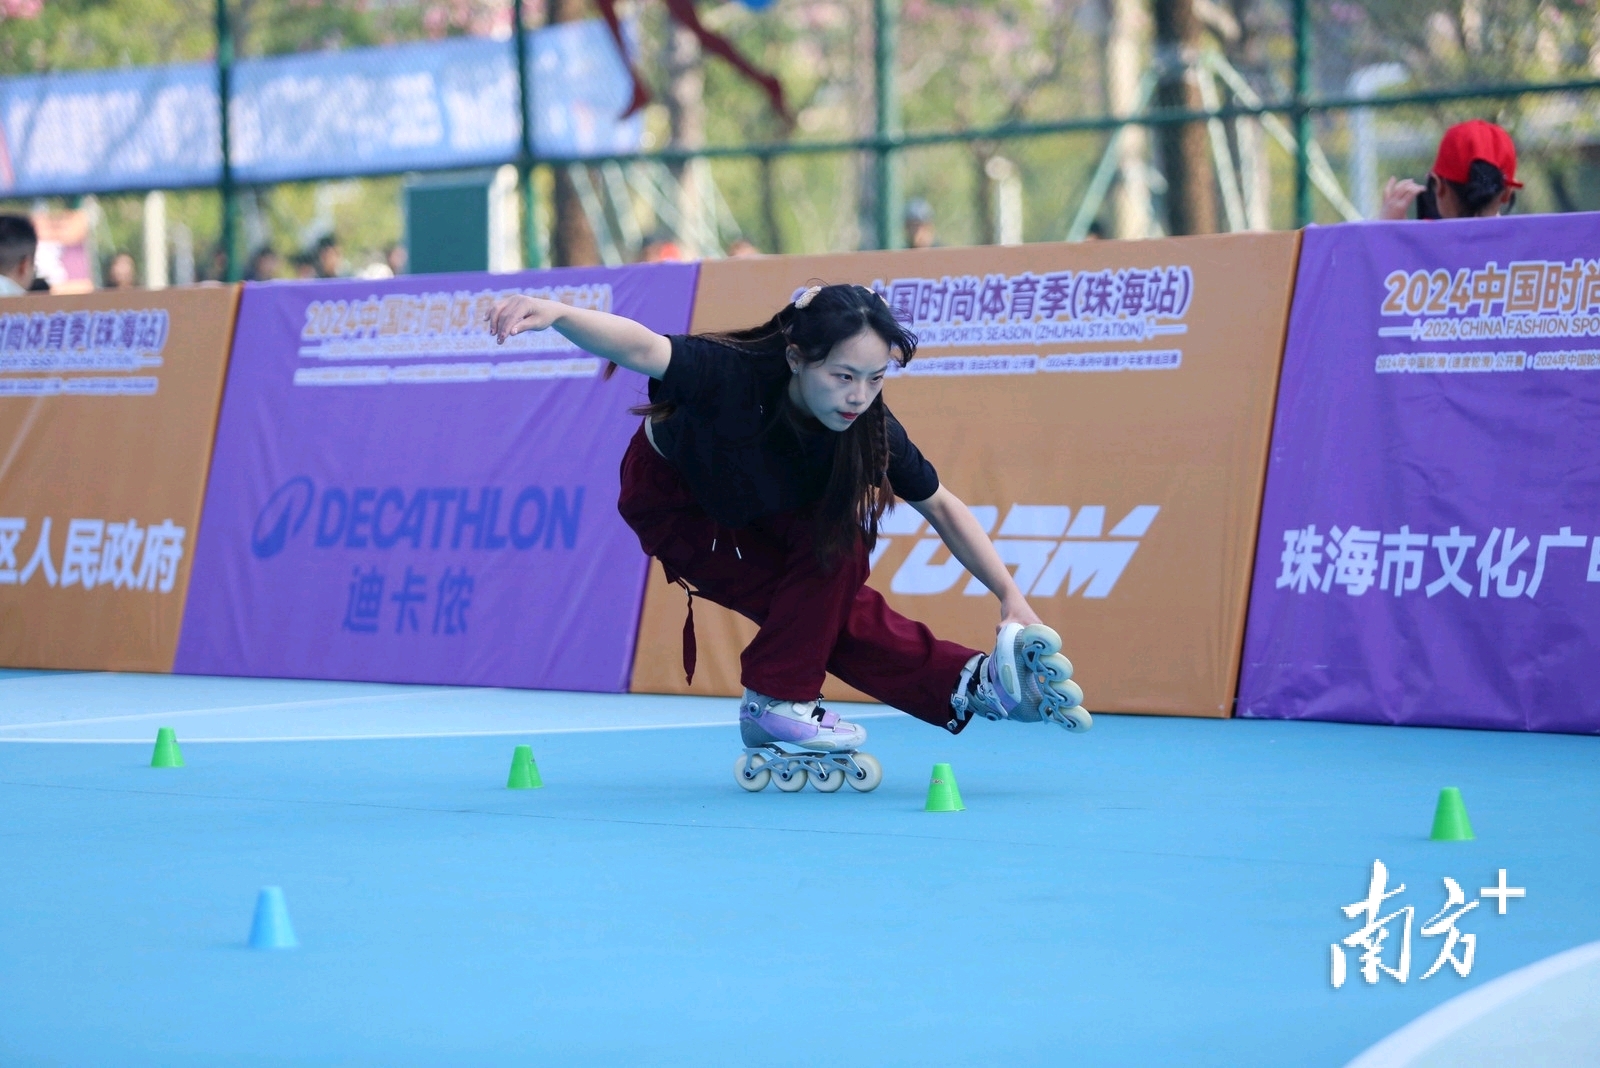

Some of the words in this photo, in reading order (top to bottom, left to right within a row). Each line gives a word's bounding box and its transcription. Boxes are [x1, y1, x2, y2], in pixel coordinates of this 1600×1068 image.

[941, 326, 985, 343] SPORTS
[986, 325, 1033, 341] SEASON
[1424, 321, 1458, 338] 2024
[1459, 319, 1503, 337] CHINA
[1505, 317, 1569, 336] FASHION
[314, 486, 586, 551] DECATHLON
[0, 517, 187, 595] 区人民政府
[342, 566, 475, 636] 迪卡侬
